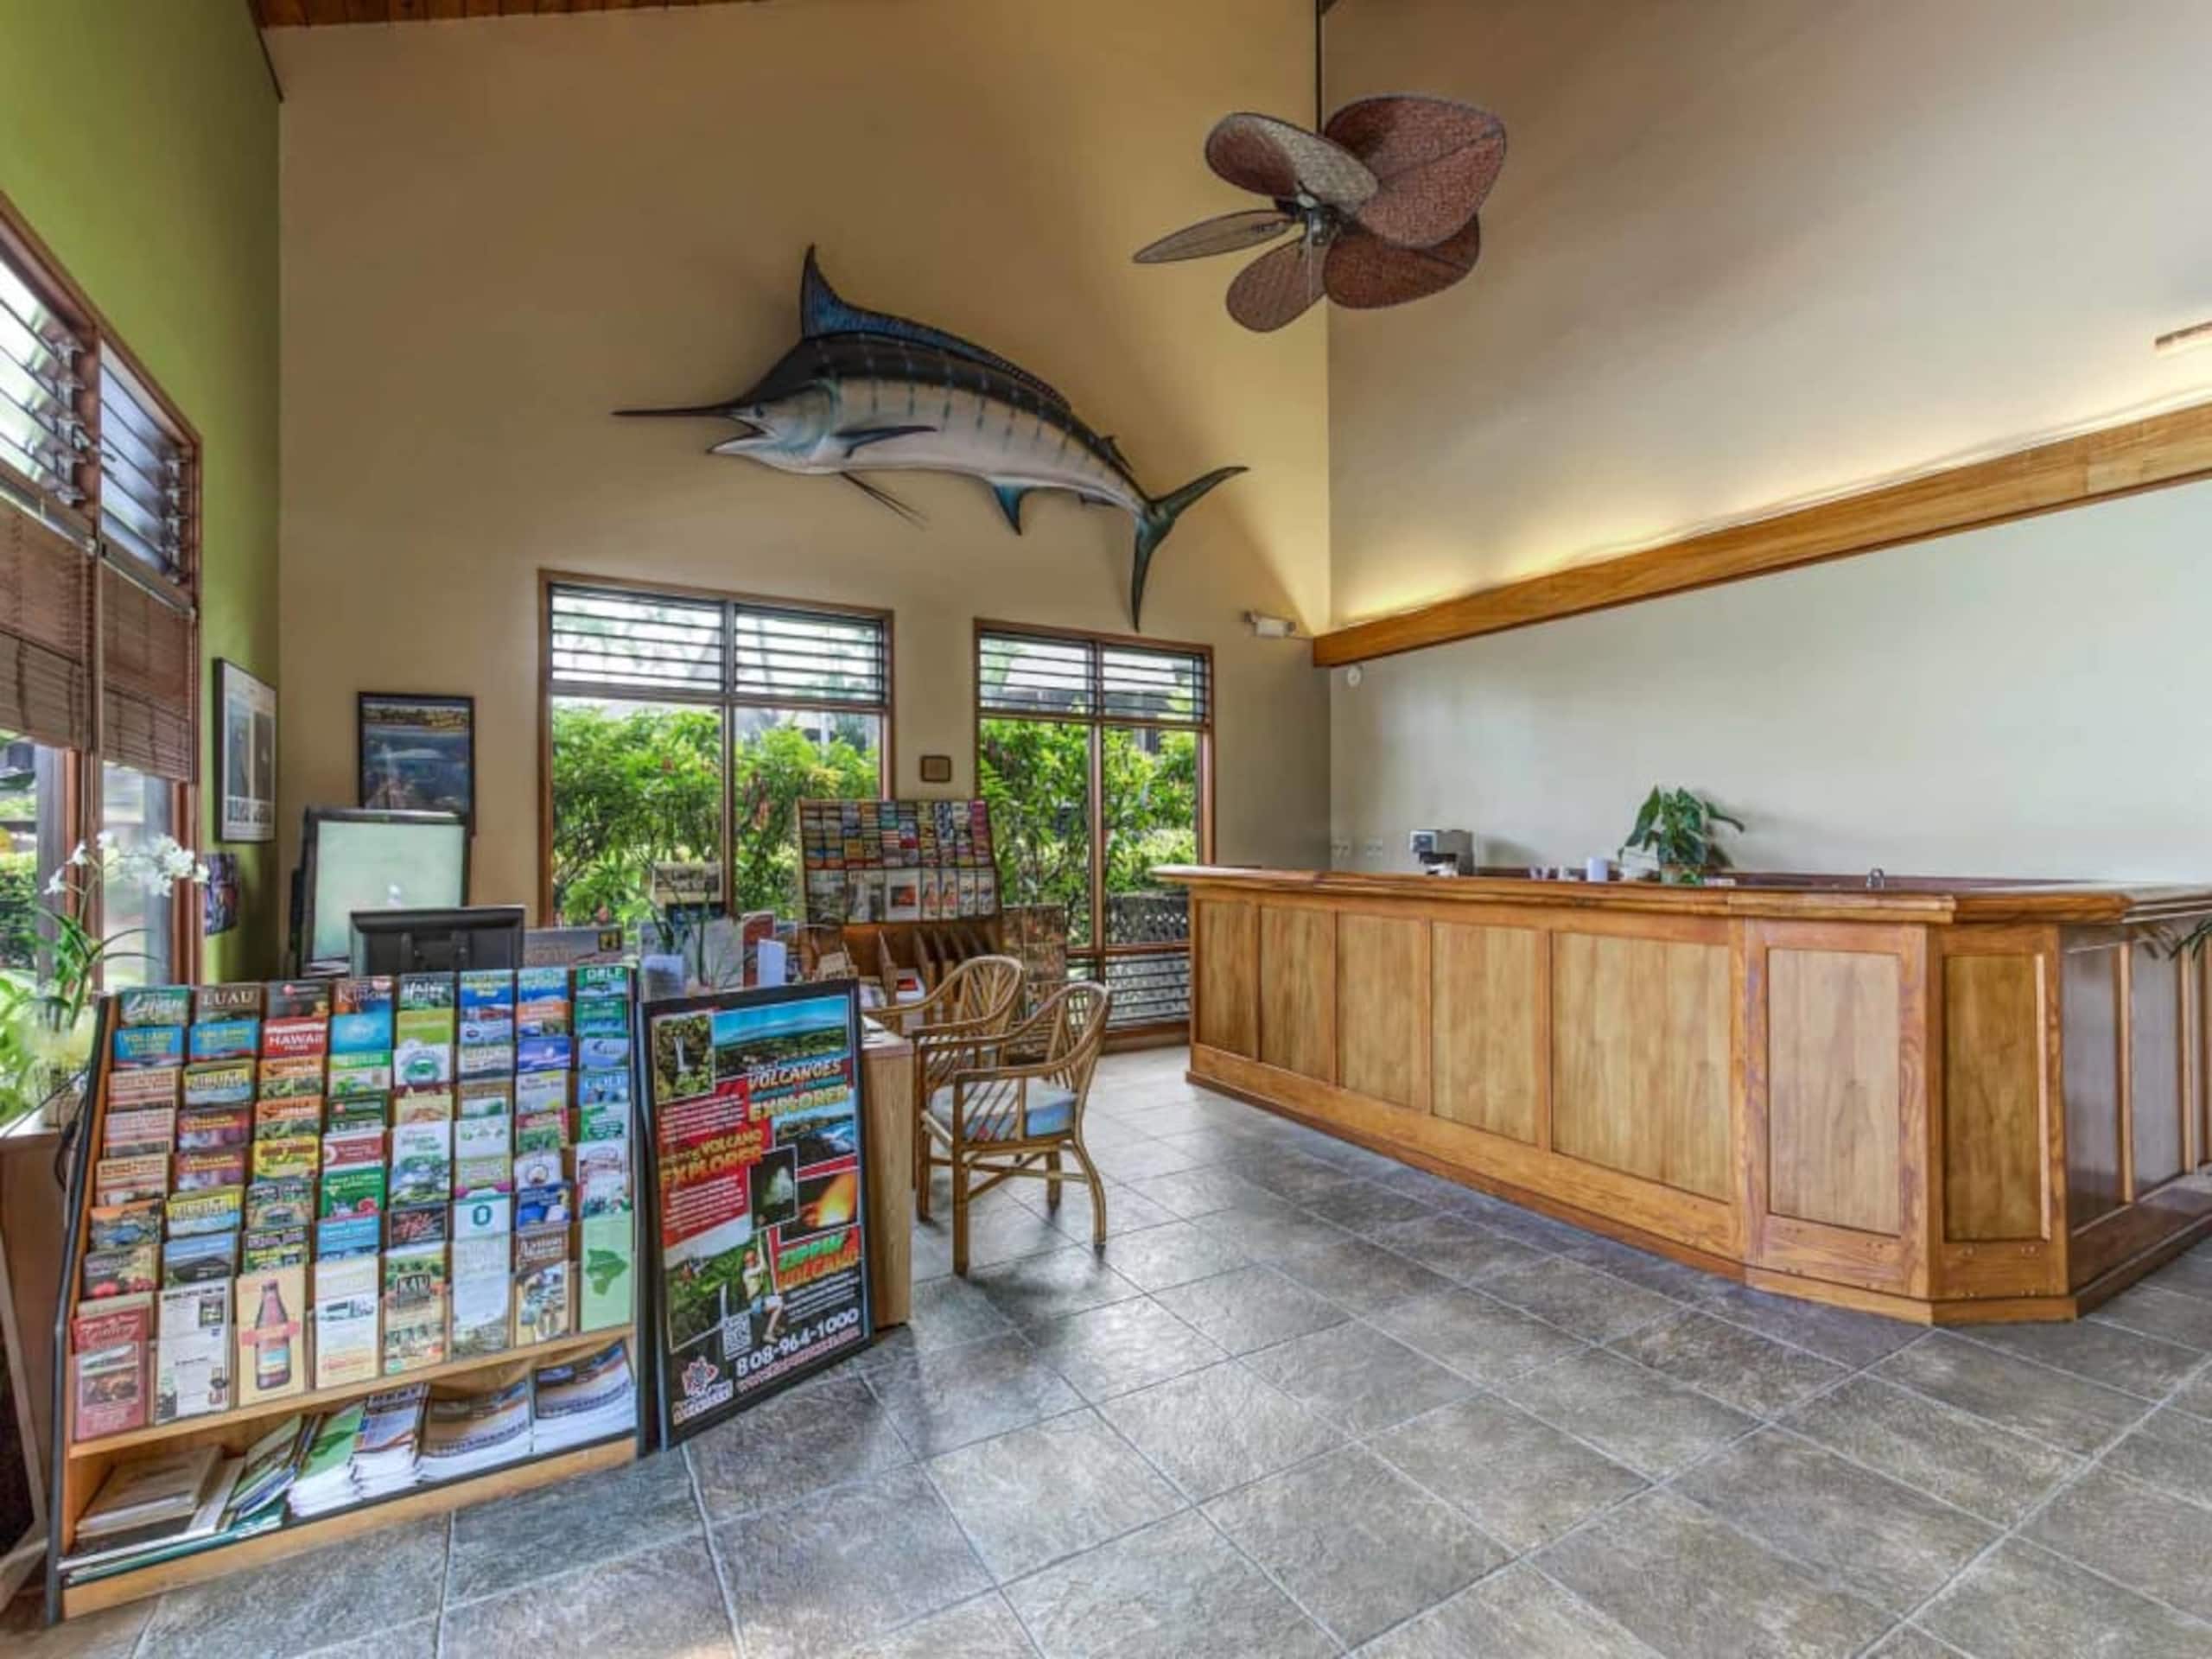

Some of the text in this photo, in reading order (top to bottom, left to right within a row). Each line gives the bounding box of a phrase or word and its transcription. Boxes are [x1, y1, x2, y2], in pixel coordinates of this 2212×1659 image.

[201, 990, 255, 1005] LUAU
[748, 1058, 842, 1091] VOLCANOES
[748, 1084, 850, 1122] EXPLORER
[701, 1128, 763, 1154] VOLCANO
[736, 1307, 860, 1377] 808-964-1000
